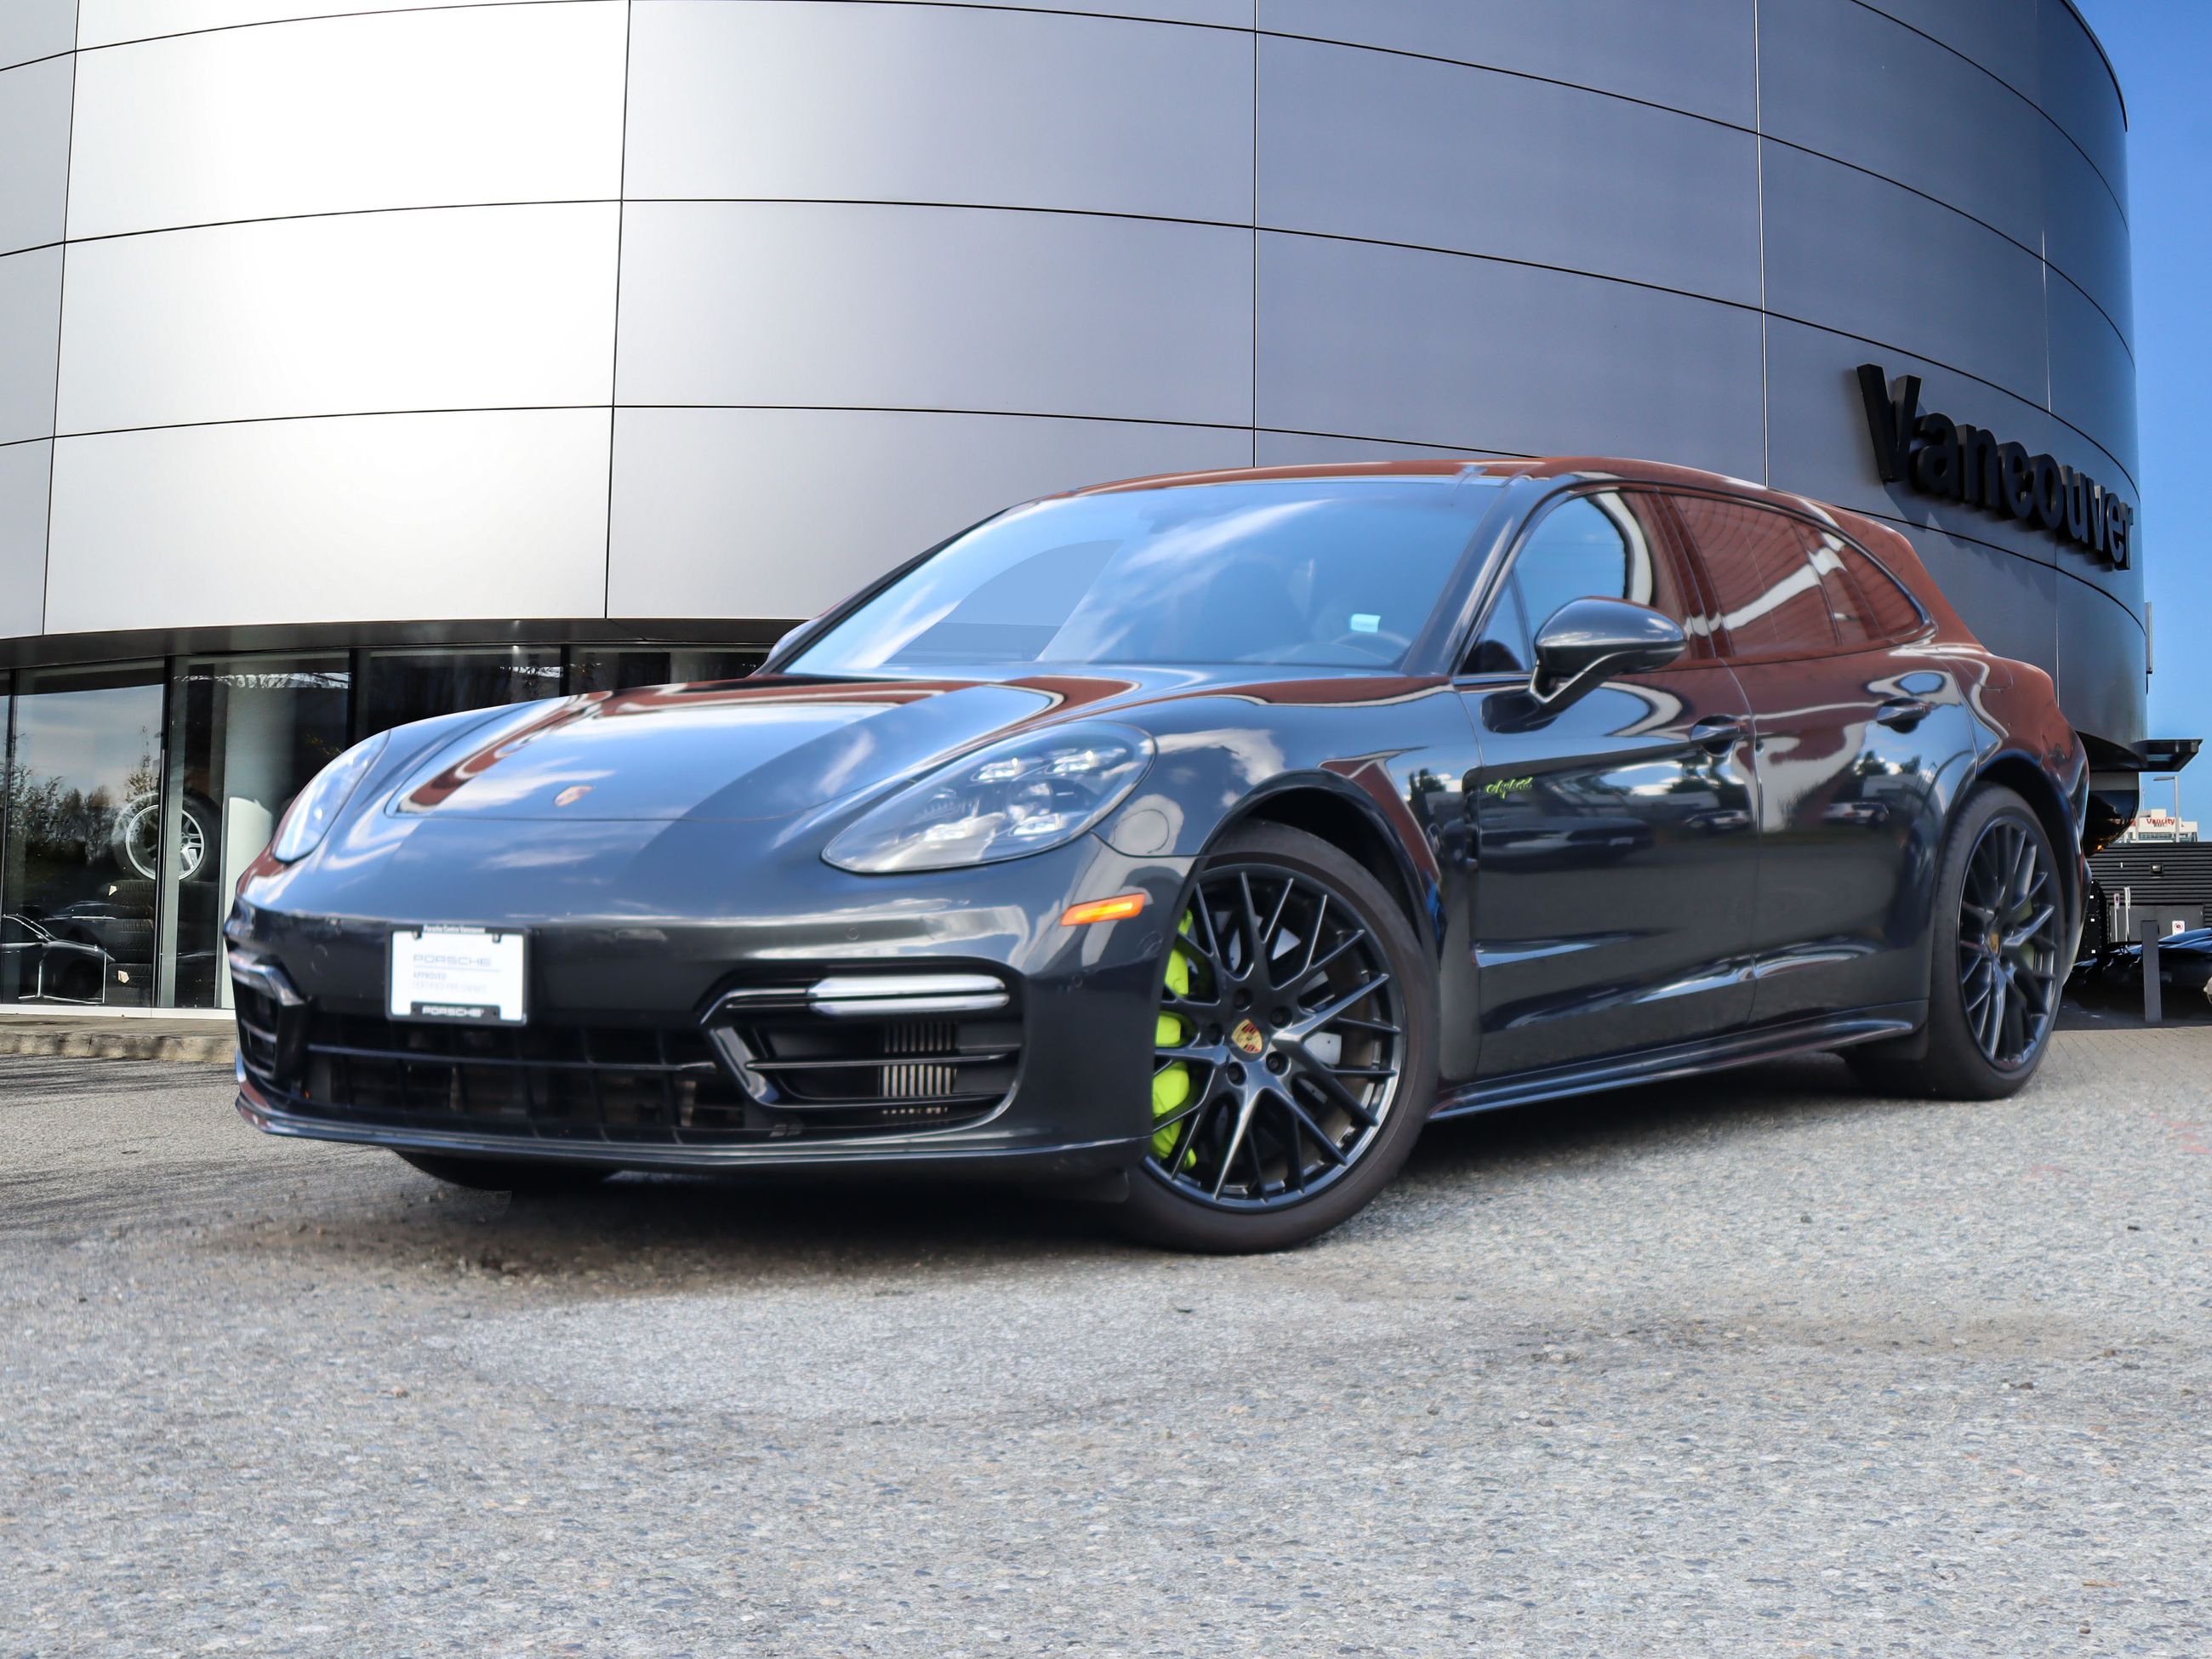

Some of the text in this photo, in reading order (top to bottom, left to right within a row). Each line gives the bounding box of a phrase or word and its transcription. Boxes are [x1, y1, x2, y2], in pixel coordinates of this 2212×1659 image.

[1857, 363, 2133, 571] Vancouver
[413, 955, 491, 966] PORSCHE
[413, 972, 447, 981] APPROVED
[423, 1006, 482, 1018] PORSCHE
